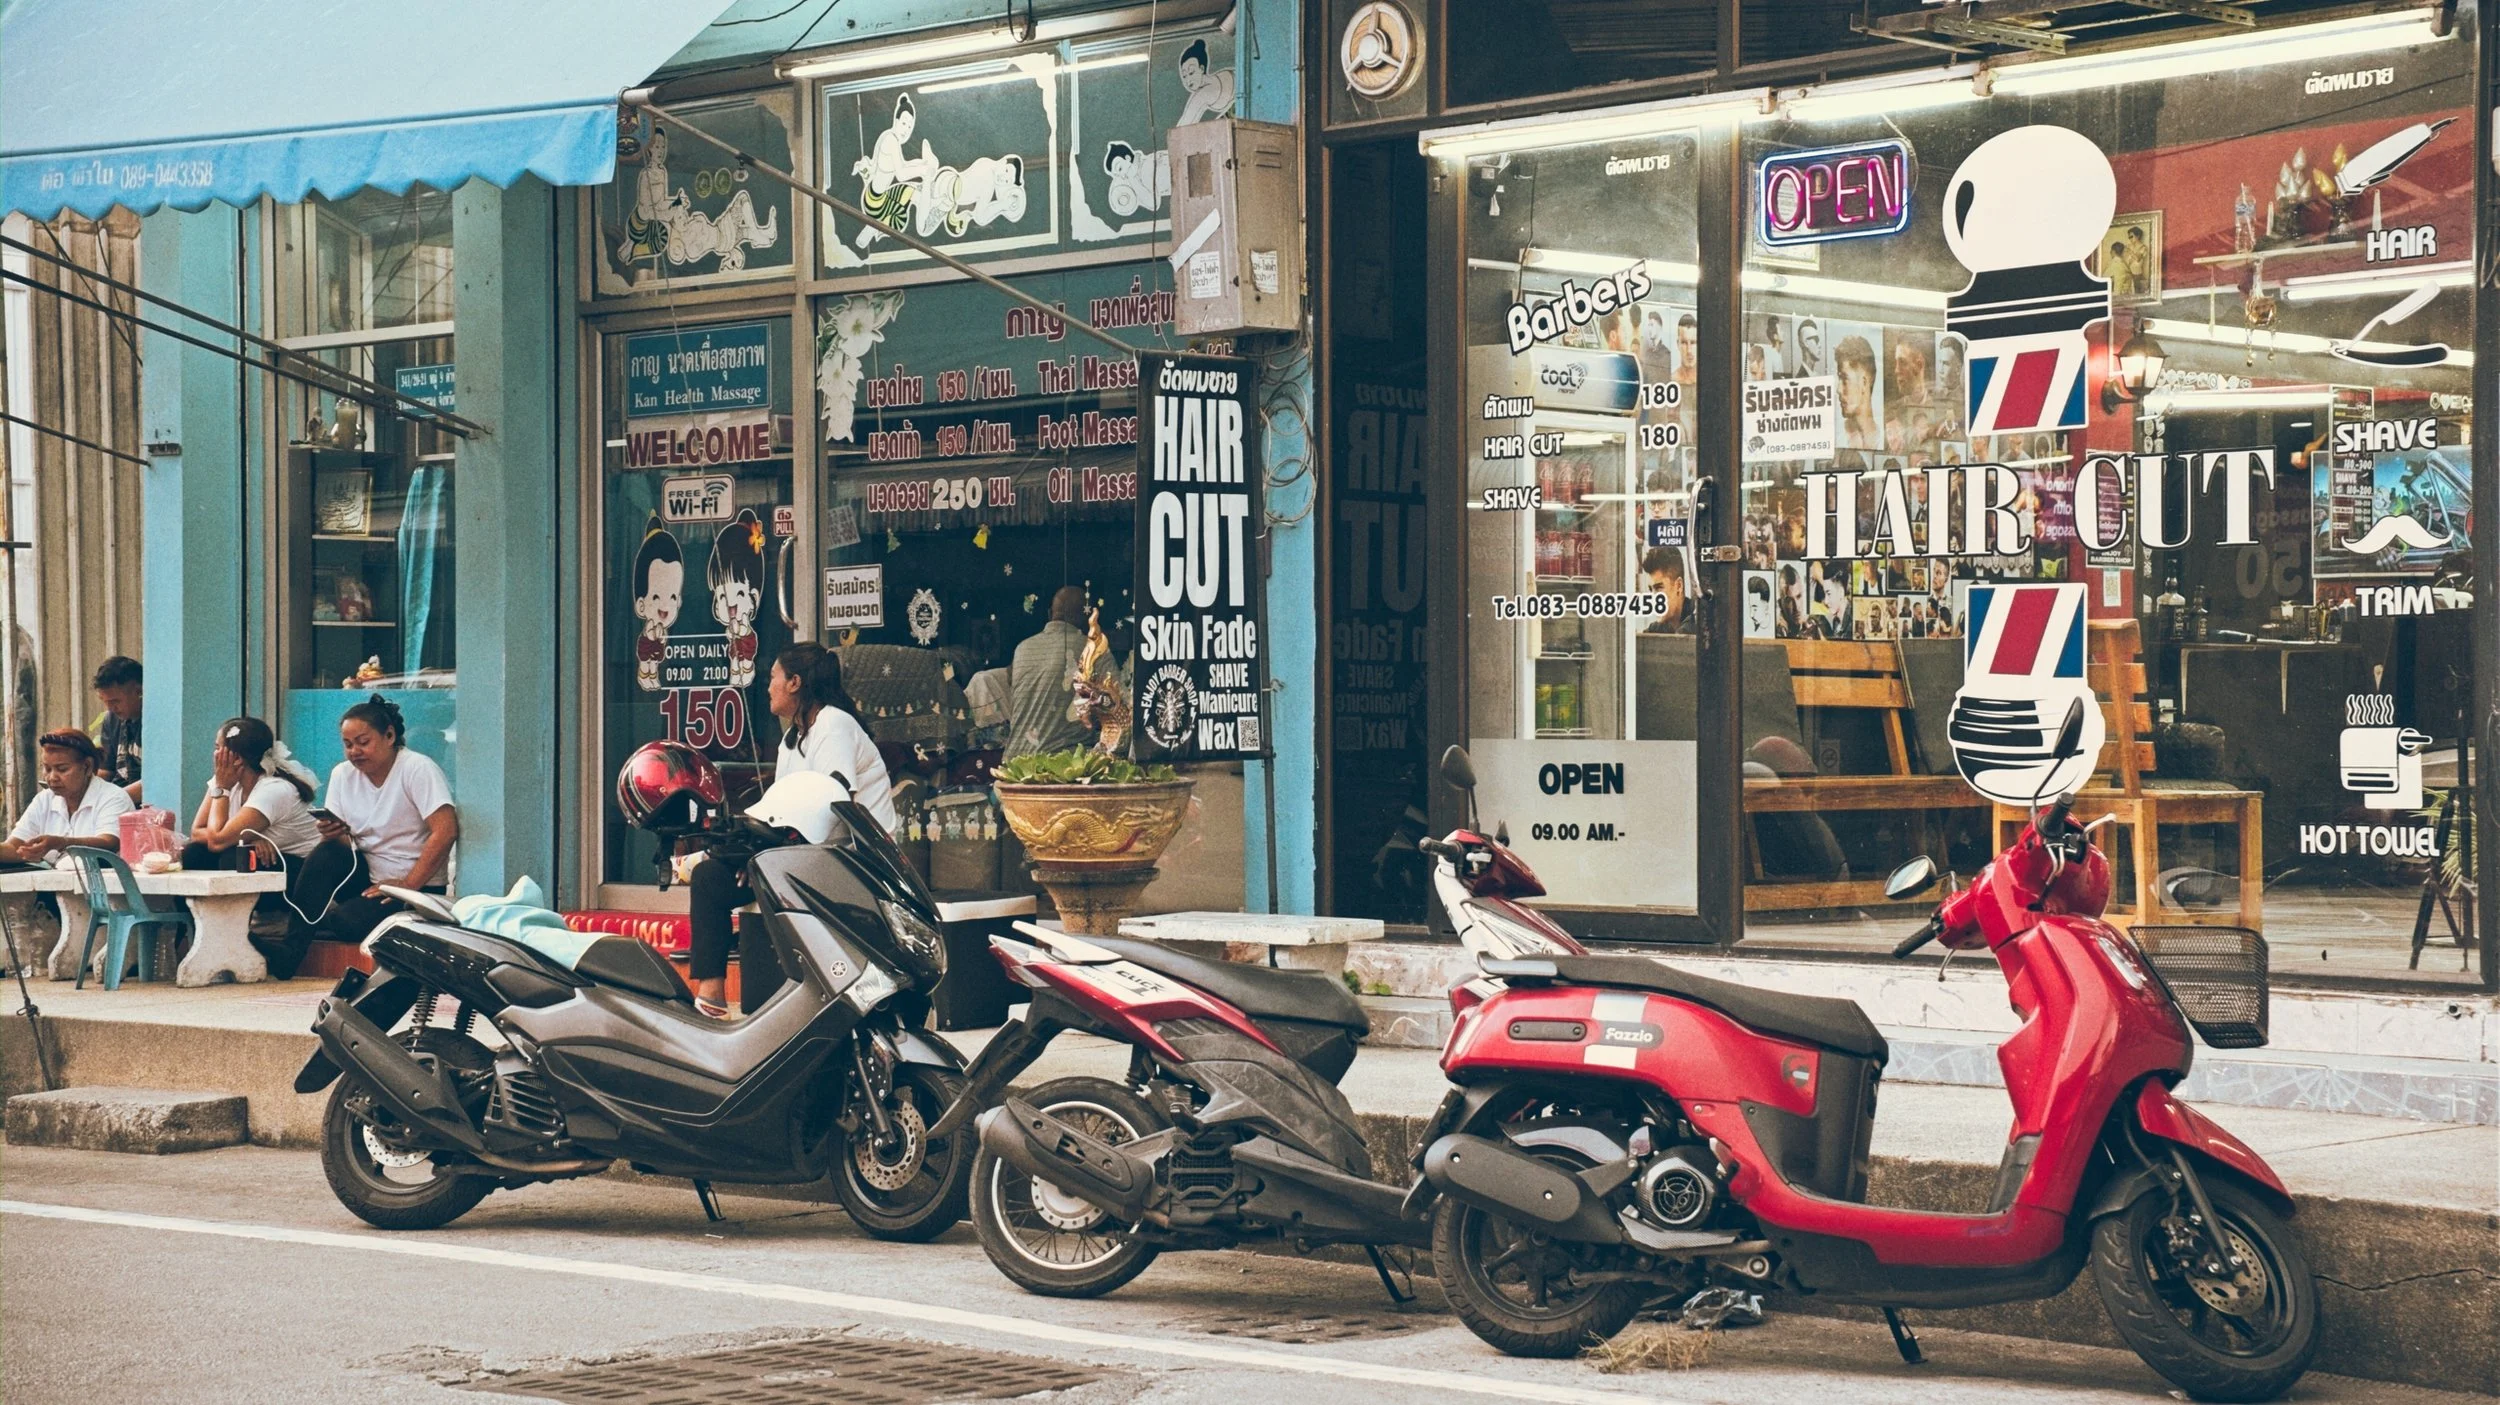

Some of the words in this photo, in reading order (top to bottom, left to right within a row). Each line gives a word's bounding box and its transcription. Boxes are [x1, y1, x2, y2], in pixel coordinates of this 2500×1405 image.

[2305, 68, 2394, 94] ตัดผมชาย
[1606, 155, 1670, 175] ตัดผมชาย
[1767, 154, 1901, 231] OPEN
[2366, 225, 2437, 263] HAIR
[1506, 258, 1652, 356] Barbers
[631, 355, 660, 384] กาญ
[668, 335, 765, 380] นวดเพื่อสุขภาพ
[867, 363, 924, 408] นวดไทย
[937, 369, 968, 403] 150
[1038, 355, 1076, 395] Thai
[1082, 355, 1138, 390] Massa
[1159, 359, 1238, 394] ตัดผมชาย
[634, 393, 658, 408] Kan
[664, 388, 704, 407] Health
[711, 385, 761, 404] Massage
[1483, 395, 1534, 419] ตัดผม
[1642, 384, 1679, 409] 180
[1746, 382, 1832, 412] รับสมัคร!
[868, 419, 921, 461] นวดเท้า
[936, 424, 967, 457] 150
[1038, 413, 1078, 450] Foot
[1082, 411, 1138, 447] Massa
[1154, 395, 1244, 483] HAIR
[1757, 413, 1821, 433] ช่างตัดผม
[2335, 417, 2437, 453] SHAVE
[626, 422, 771, 468] WELCOME
[1483, 435, 1524, 459] HAIR
[1530, 433, 1563, 455] CUT
[1642, 426, 1679, 451] 180
[668, 490, 700, 498] FREE
[932, 476, 983, 511] 250
[988, 476, 1016, 507] ชม.
[1047, 467, 1073, 503] Oil
[1082, 466, 1137, 502] Massa
[1483, 487, 1541, 510] SHAVE
[1801, 462, 2031, 562] HAIR
[2073, 445, 2277, 552] CUT
[669, 497, 718, 516] Wi-Fi
[775, 521, 793, 535] PULL
[1656, 521, 1684, 538] ผลัก
[1149, 491, 1249, 608] CUT
[827, 577, 880, 597] รับสมัคร!
[2356, 586, 2435, 617] TRIM
[829, 603, 879, 619] หมอนวด
[1493, 594, 1667, 618] Tel.083-0887458
[665, 646, 694, 660] OPEN
[699, 644, 729, 658] DAILY
[1141, 613, 1195, 661] Skin
[1202, 614, 1256, 660] Fade
[666, 667, 692, 682] 09.00
[703, 666, 728, 680] 21.00
[1141, 672, 1161, 708] ENJOY
[1158, 664, 1187, 685] BARBER
[1184, 676, 1199, 706] SHOP
[1209, 663, 1249, 688] SHAVE
[1199, 690, 1258, 714] Manicure
[660, 688, 744, 749] 150
[1198, 718, 1236, 751] Wax
[1539, 763, 1624, 795] OPEN
[1532, 823, 1579, 840] 09.00
[1586, 824, 1625, 841] AM.-
[2300, 824, 2350, 854] HOT
[2355, 824, 2440, 857] TOWEL
[1605, 1027, 1653, 1043] Fazzio
